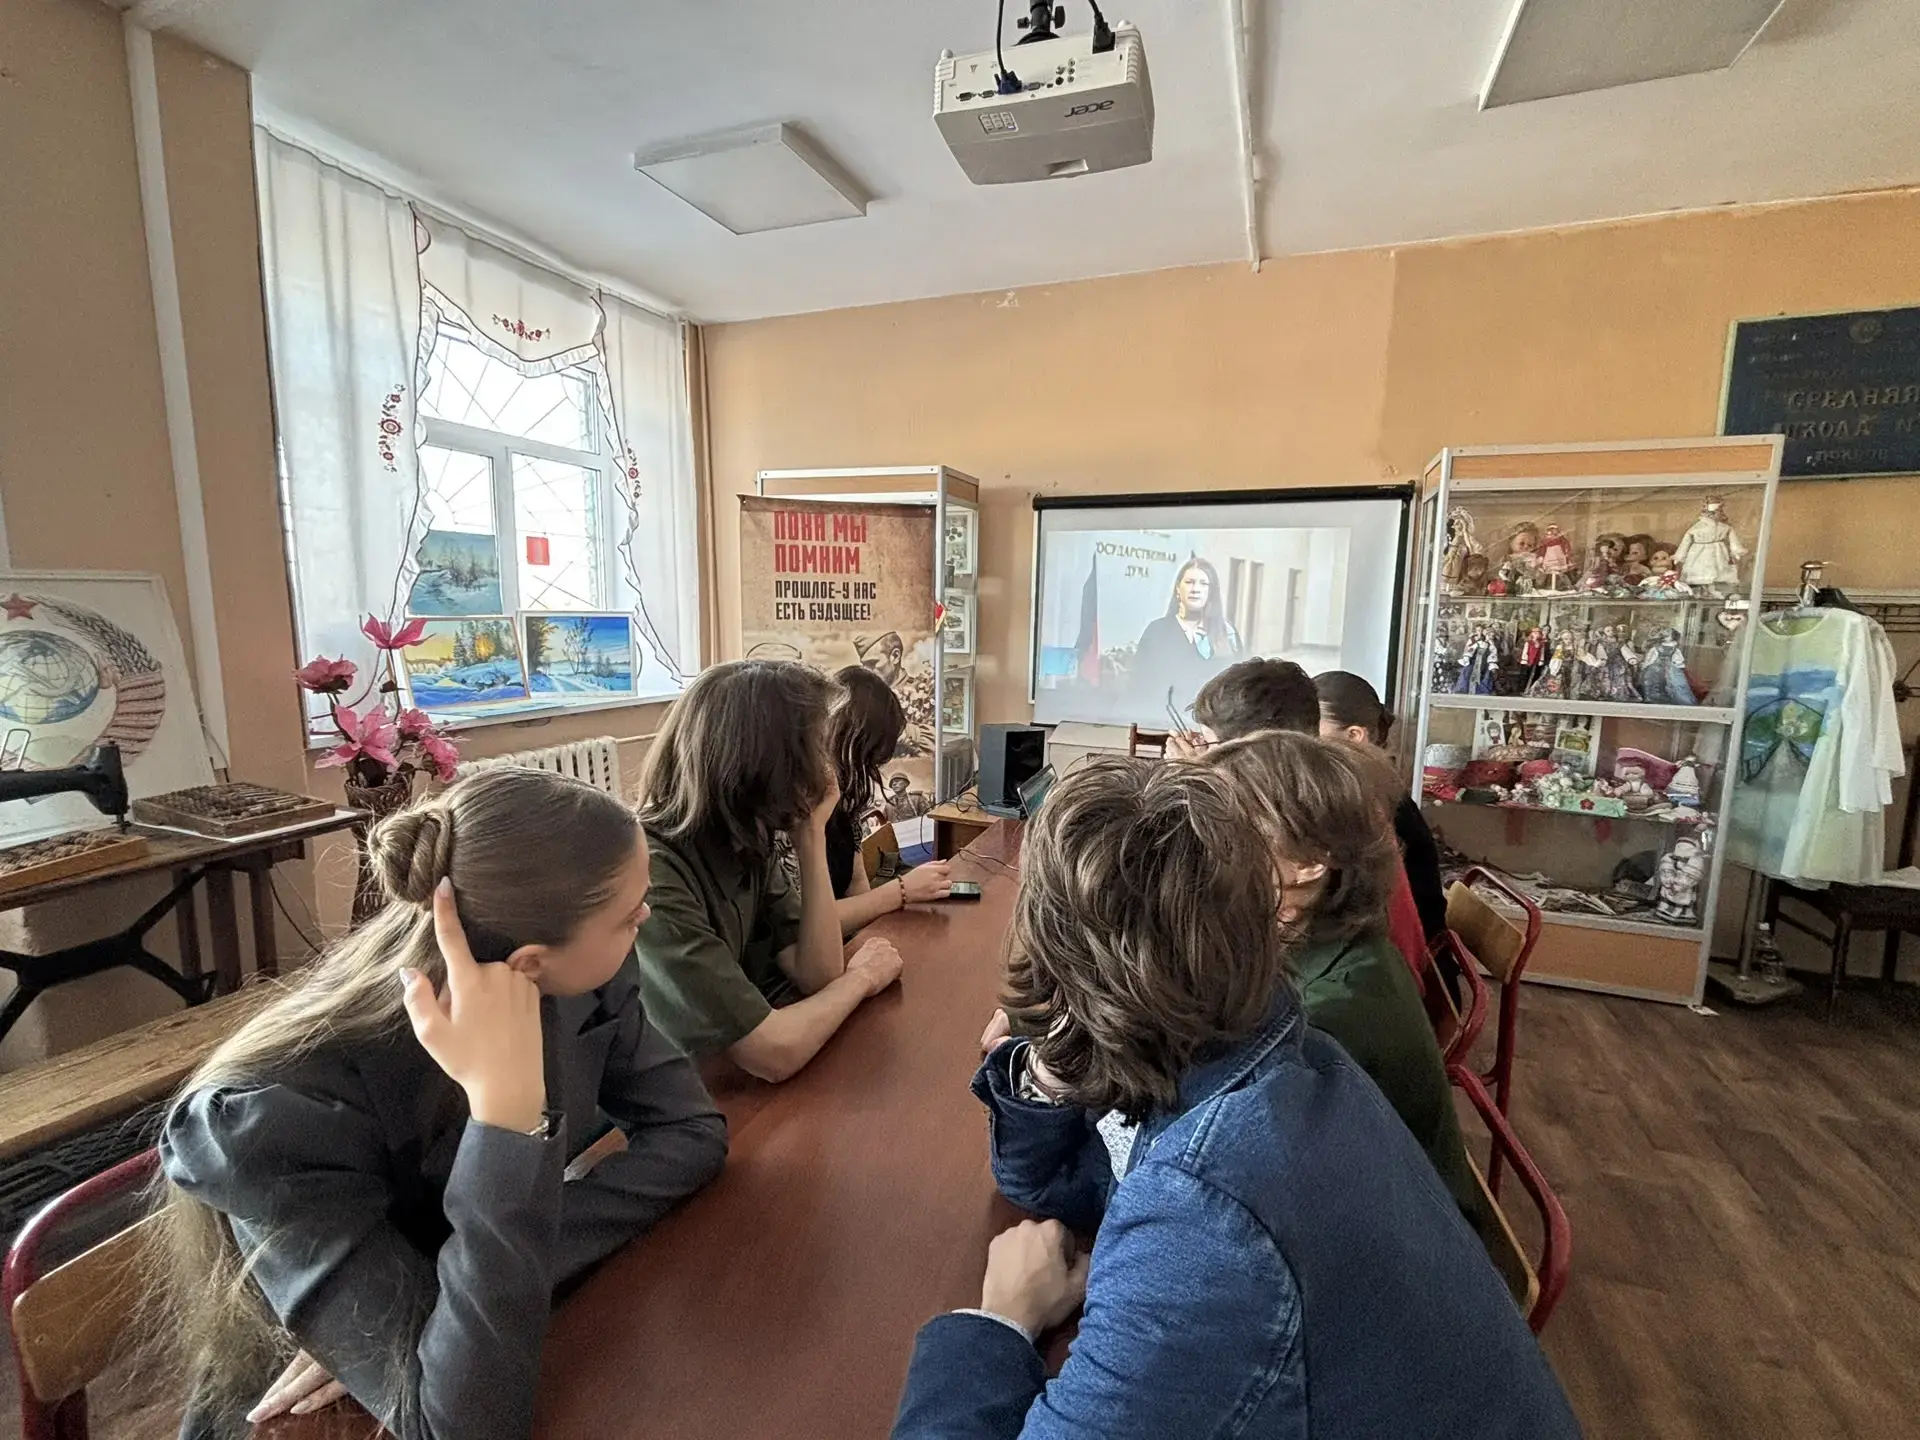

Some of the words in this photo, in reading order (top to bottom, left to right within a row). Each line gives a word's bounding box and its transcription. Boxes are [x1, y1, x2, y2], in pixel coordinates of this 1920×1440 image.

[1064, 100, 1115, 118] acer
[773, 510, 826, 542] ПОКА
[833, 513, 867, 543] МЫ
[774, 544, 861, 574] ПОМНИМ
[853, 581, 877, 600] НАС
[776, 602, 805, 621] ЕСТЬ
[809, 602, 871, 622] БУДУЩЕЕ!
